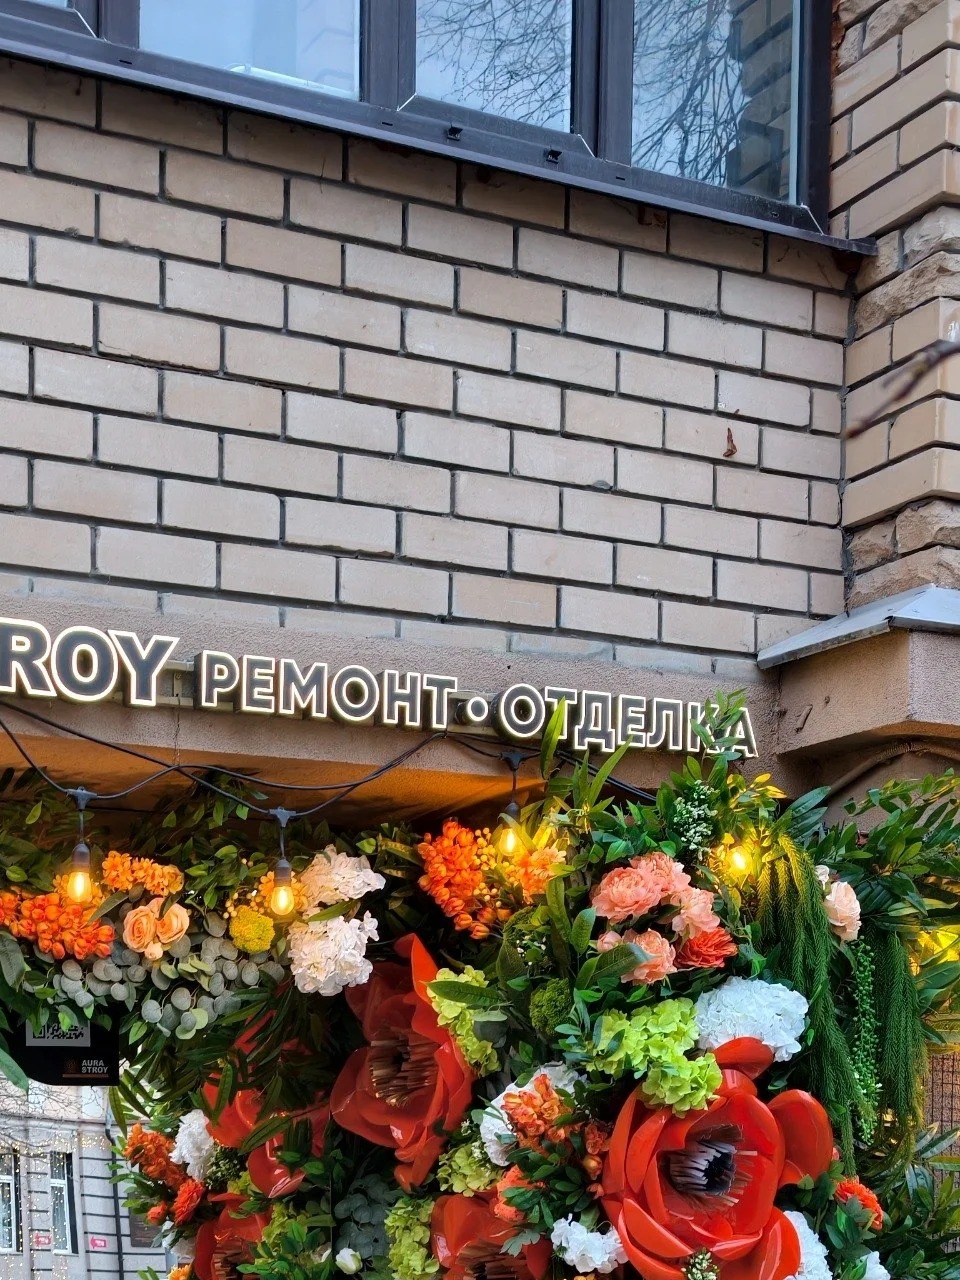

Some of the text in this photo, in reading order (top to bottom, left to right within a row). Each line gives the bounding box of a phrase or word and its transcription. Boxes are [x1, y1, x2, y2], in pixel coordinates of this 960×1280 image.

[200, 649, 759, 758] РЕМОНТ ОТДЕЛКА
[81, 1059, 105, 1067] AURA
[81, 1066, 109, 1074] STROY
